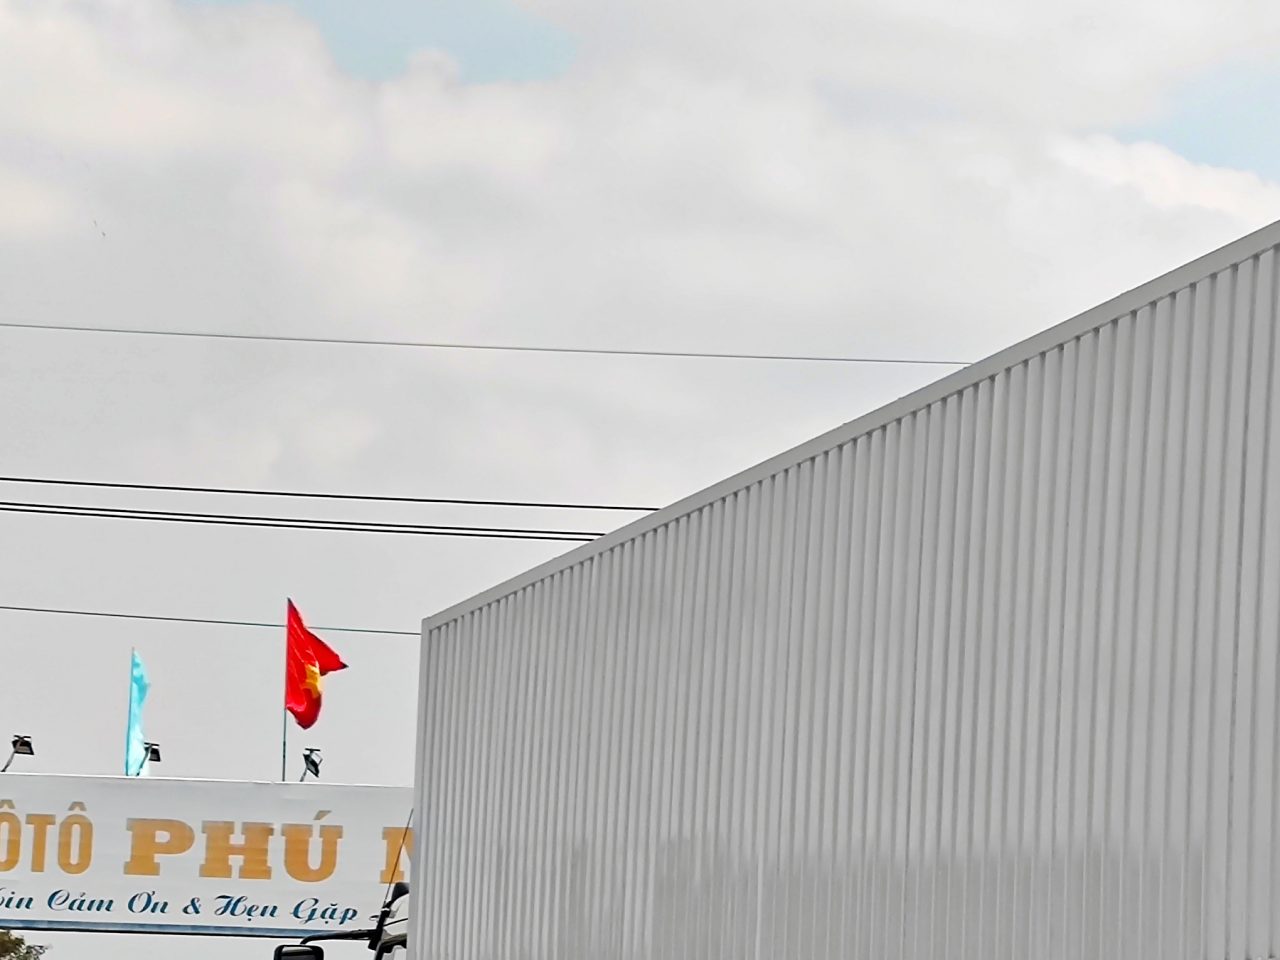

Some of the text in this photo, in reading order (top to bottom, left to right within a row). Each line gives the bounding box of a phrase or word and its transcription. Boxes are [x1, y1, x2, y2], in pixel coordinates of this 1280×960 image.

[123, 810, 344, 883] PHÚ
[127, 891, 169, 914] Ơn
[182, 897, 202, 915] &
[214, 895, 278, 921] Hẹn
[290, 897, 358, 925] Gặp
